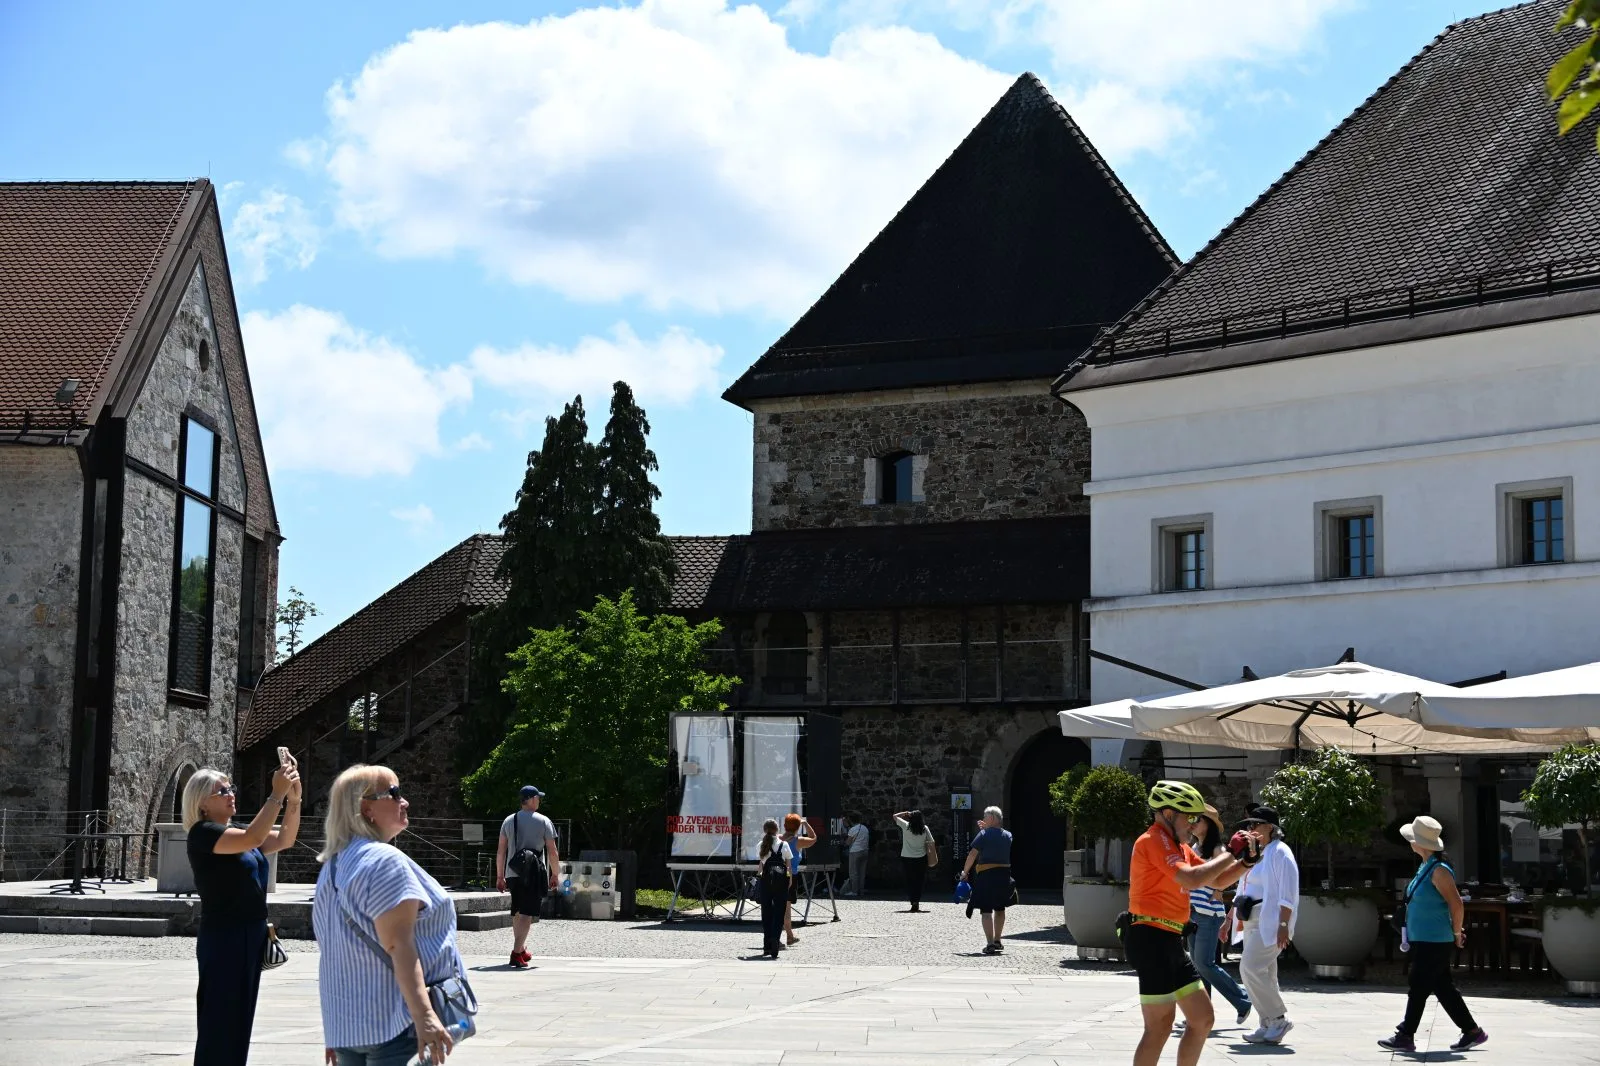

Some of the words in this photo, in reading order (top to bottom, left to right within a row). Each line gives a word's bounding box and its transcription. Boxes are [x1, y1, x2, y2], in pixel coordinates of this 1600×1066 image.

[667, 816, 684, 824] POD
[686, 816, 728, 824] ZVEZDAMI
[667, 825, 695, 833] UNDER
[697, 825, 713, 833] THE
[715, 825, 743, 835] STARS
